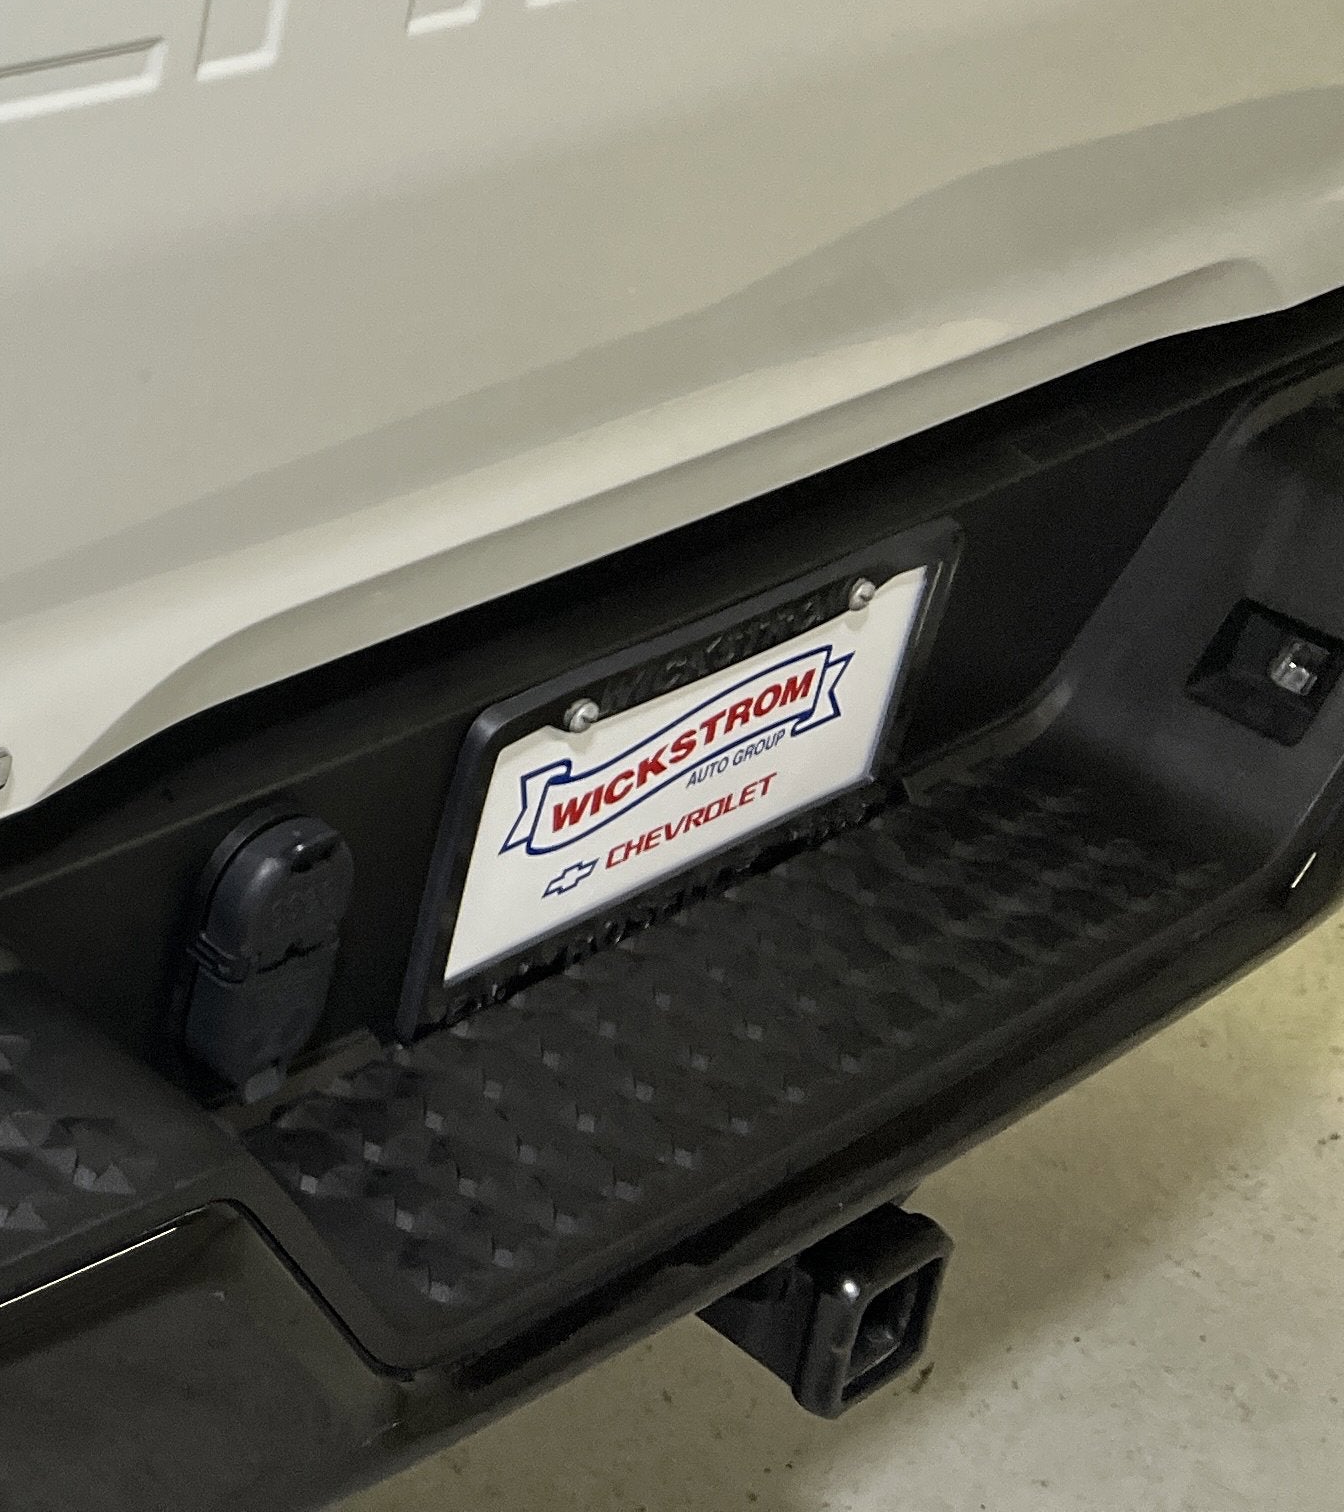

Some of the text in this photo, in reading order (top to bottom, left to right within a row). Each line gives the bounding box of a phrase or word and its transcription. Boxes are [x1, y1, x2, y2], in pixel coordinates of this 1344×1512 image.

[551, 667, 817, 834] WICKSTROM
[685, 728, 786, 789] AUTO GROUP
[605, 771, 778, 870] CHEVROLET
